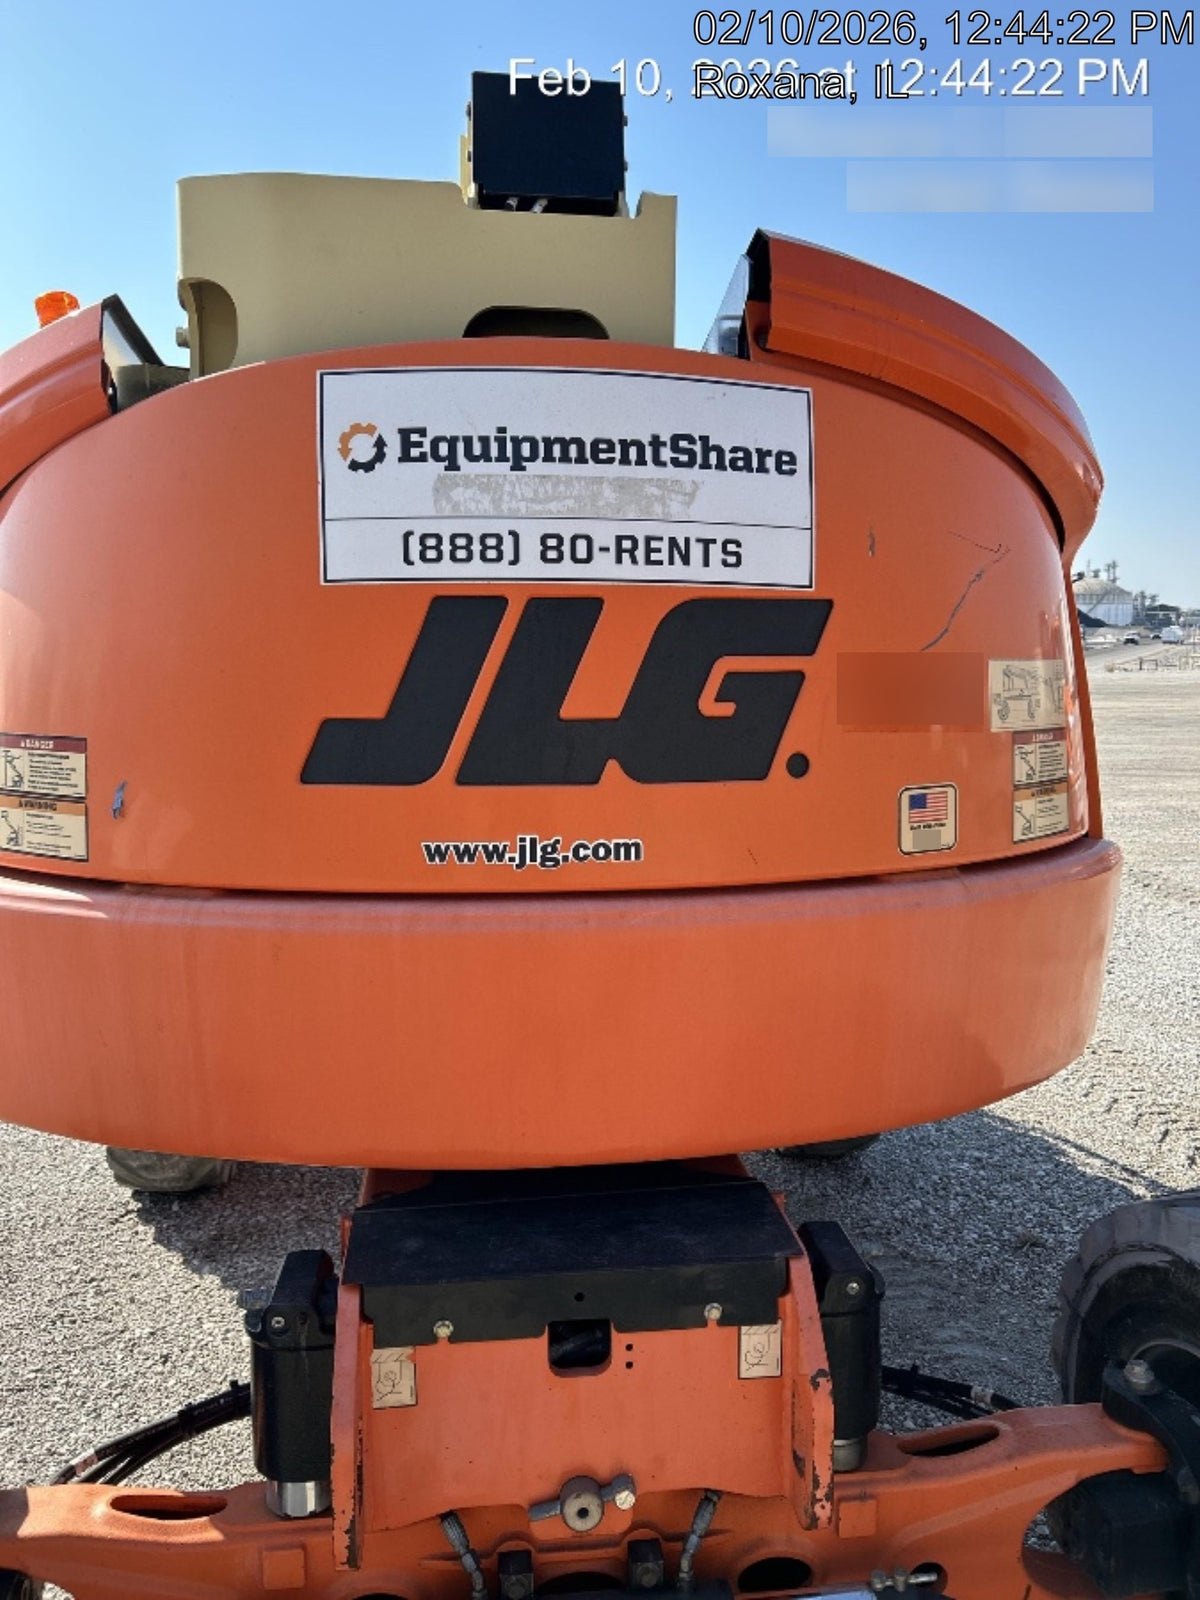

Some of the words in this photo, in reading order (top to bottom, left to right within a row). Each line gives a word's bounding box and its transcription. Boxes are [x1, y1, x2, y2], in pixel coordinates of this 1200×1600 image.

[397, 426, 798, 476] EquipmentShare
[402, 530, 521, 567] (888)
[539, 532, 744, 569] 80-RENTS
[422, 834, 643, 869] www.jlg.com
